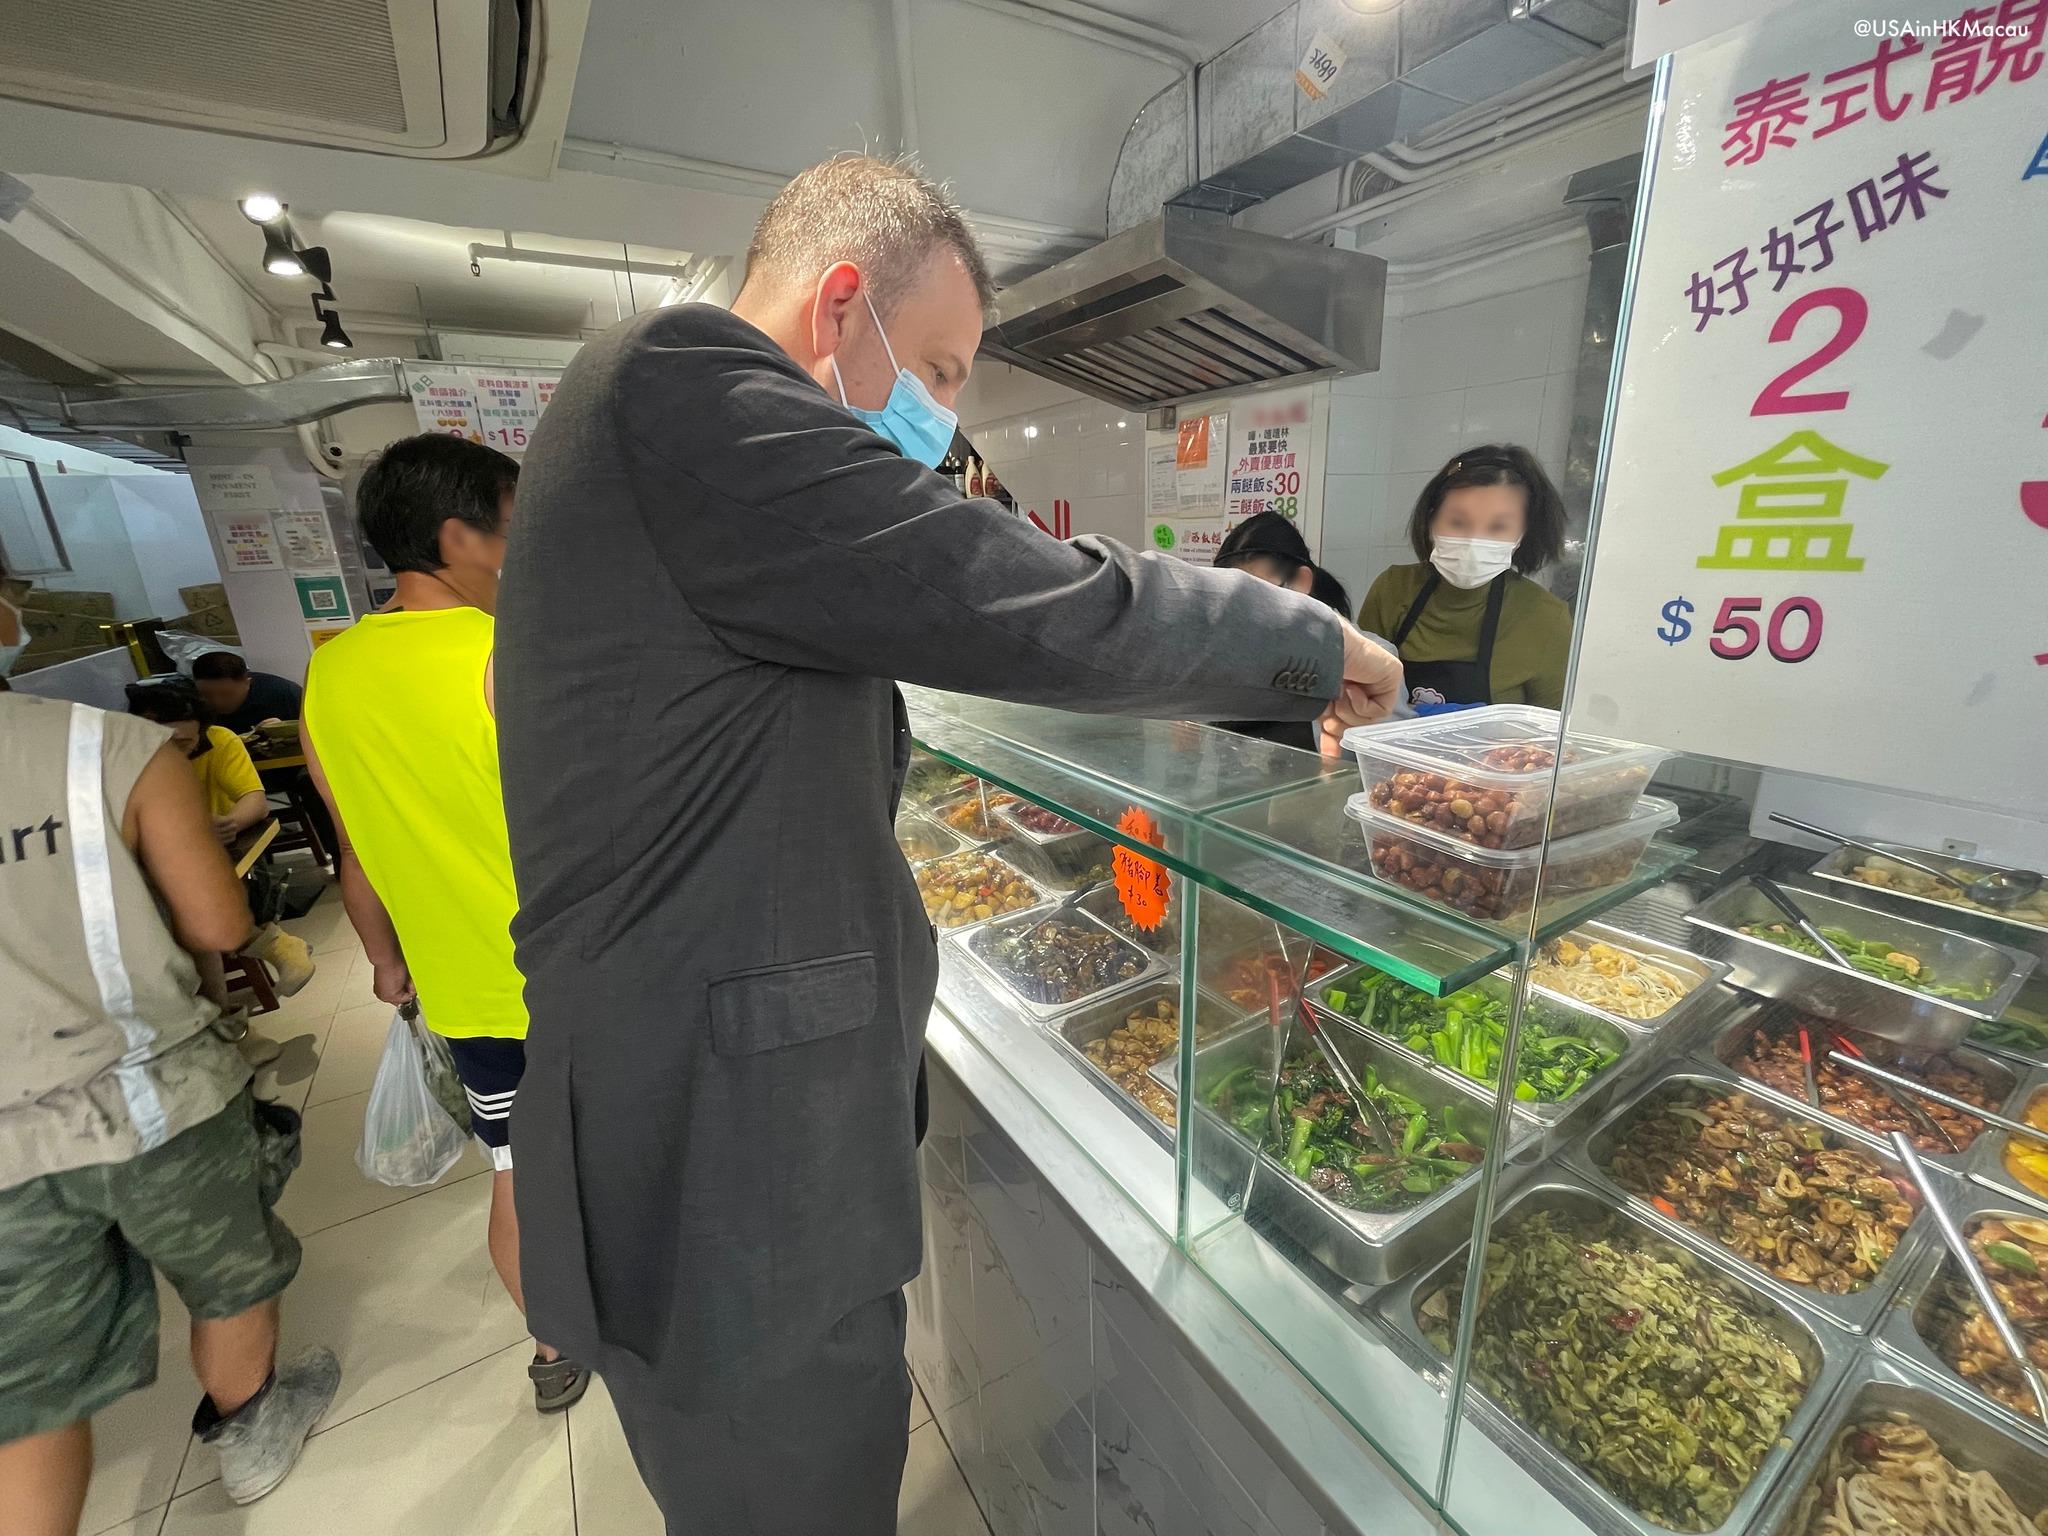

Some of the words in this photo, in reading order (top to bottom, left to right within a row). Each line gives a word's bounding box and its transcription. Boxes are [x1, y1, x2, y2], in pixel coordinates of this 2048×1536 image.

[1684, 150, 1950, 333] 好好味
[1750, 286, 1869, 417] 2
[488, 428, 527, 446] $15
[1248, 440, 1288, 455] 最緊要快
[1239, 453, 1297, 472] 外賣優惠價
[1696, 429, 1891, 573] 盒
[0, 814, 63, 864] rt
